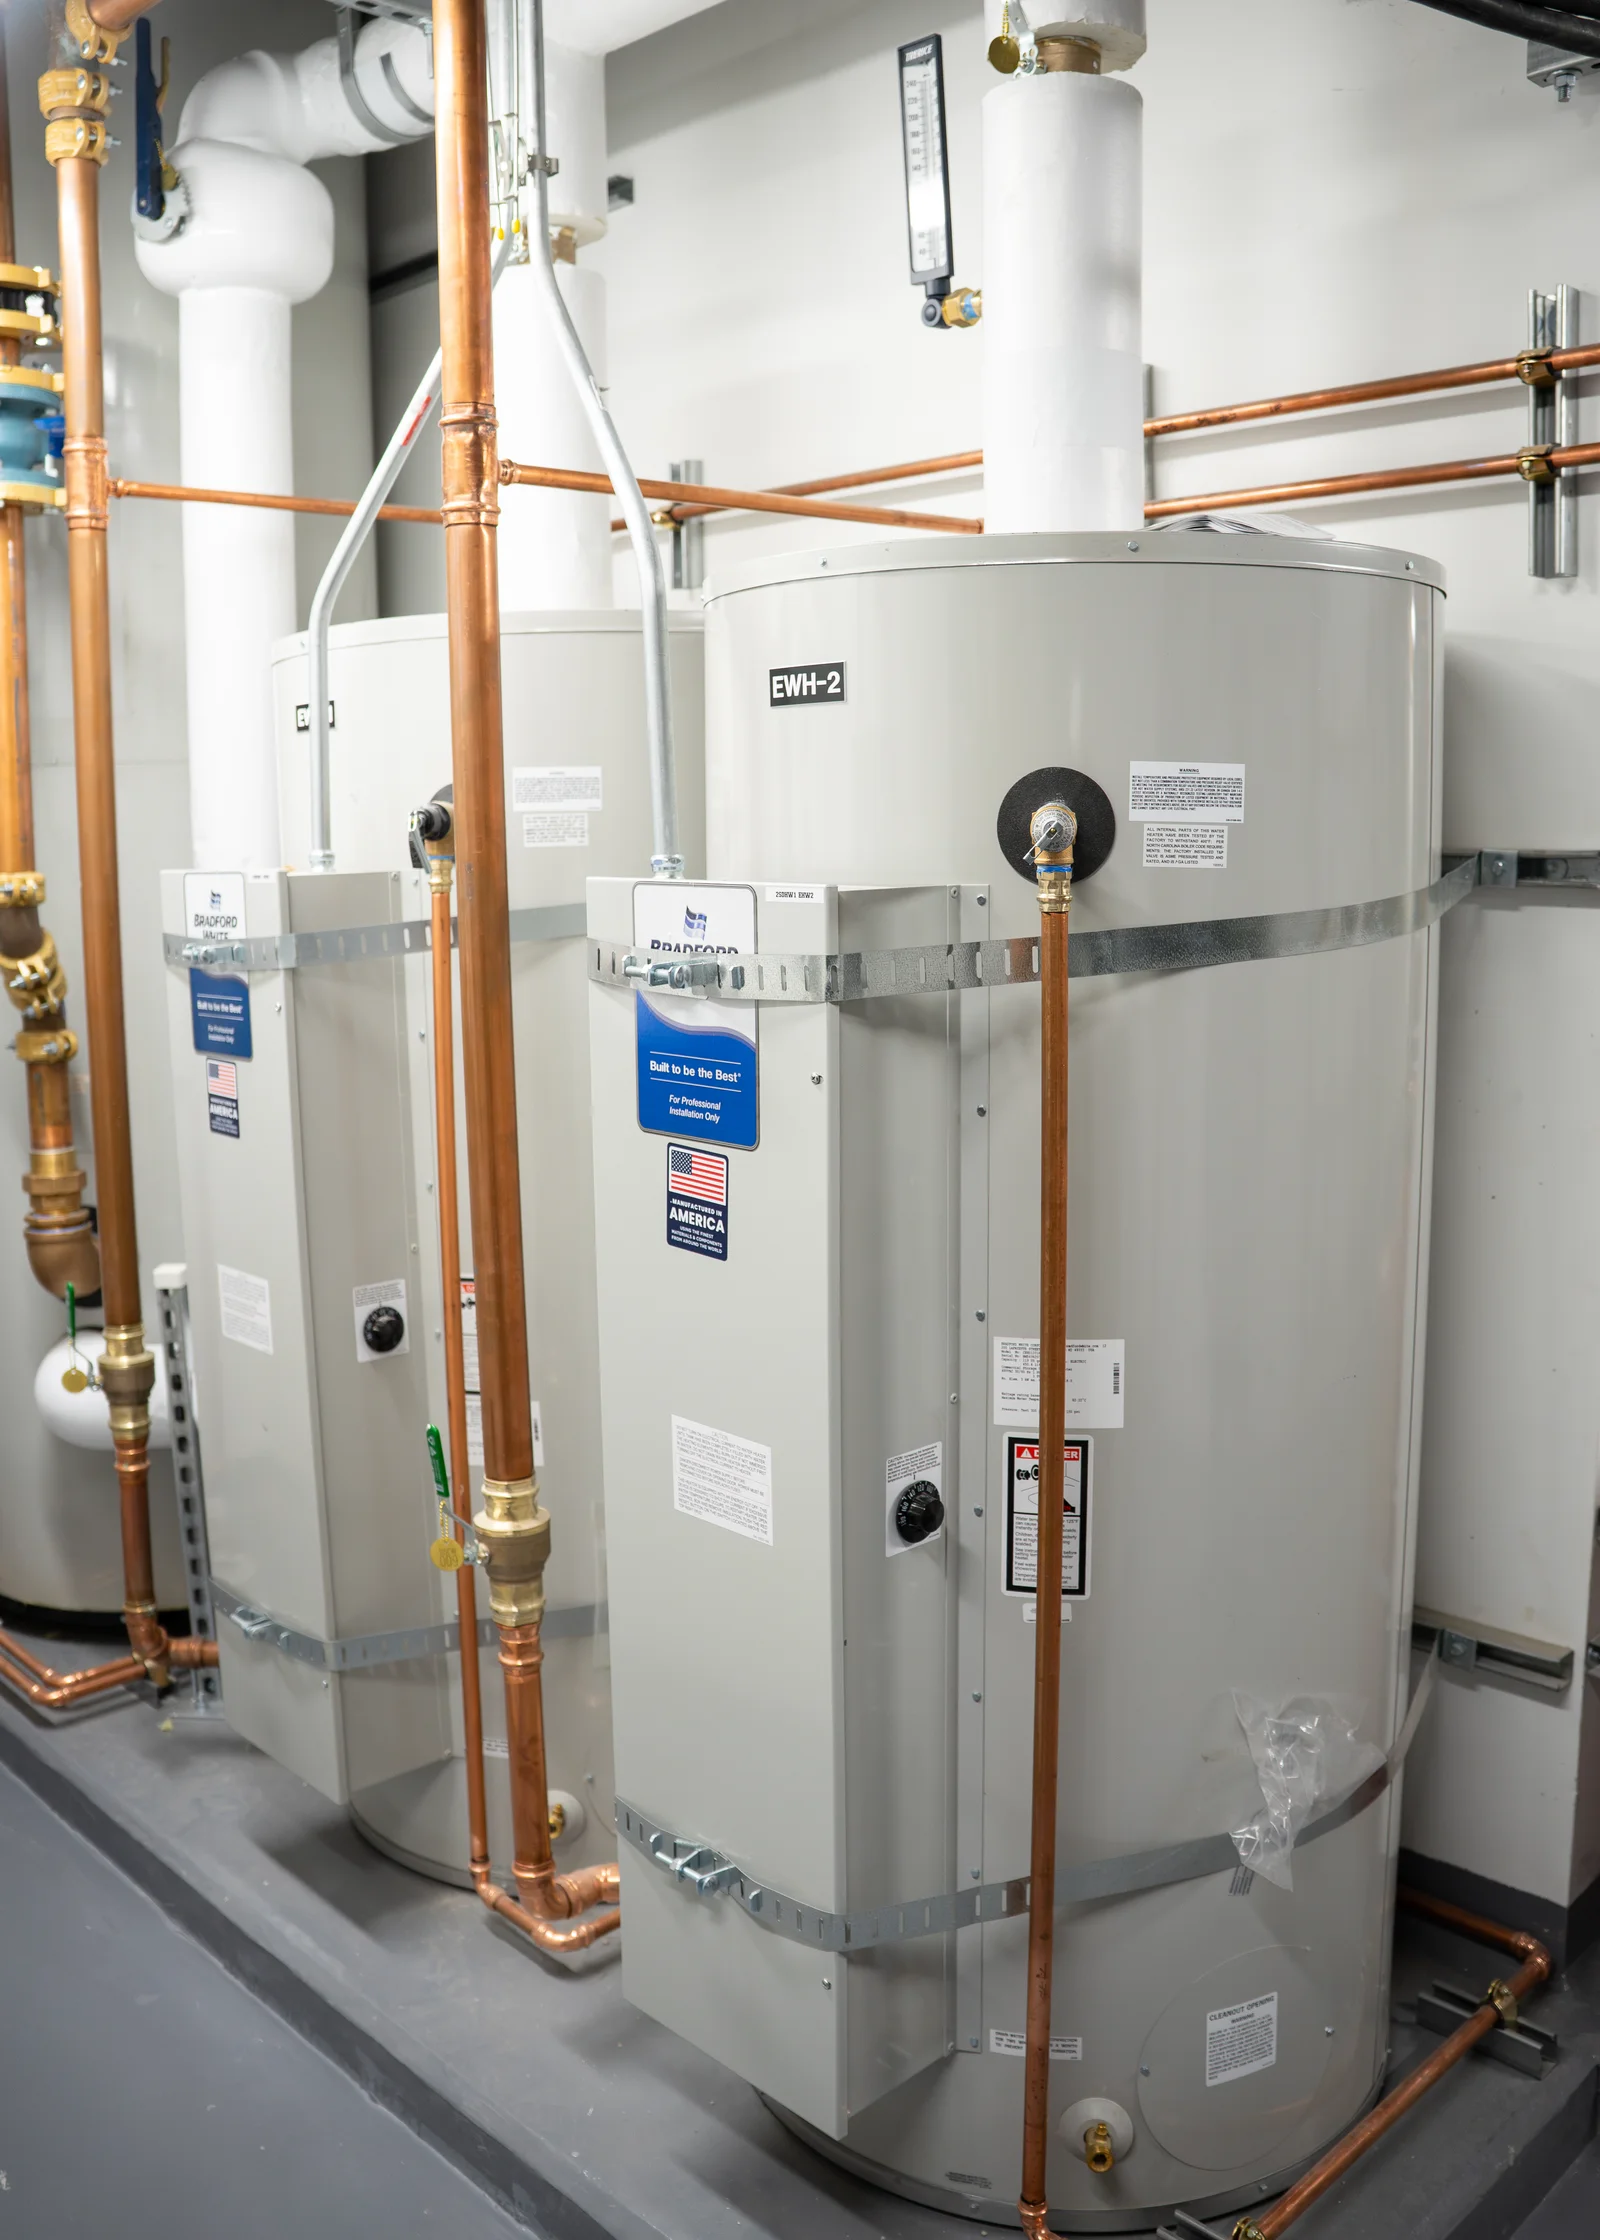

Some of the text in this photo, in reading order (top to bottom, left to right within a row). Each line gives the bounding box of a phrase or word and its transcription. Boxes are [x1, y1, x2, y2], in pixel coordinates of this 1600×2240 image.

[772, 671, 841, 698] EWH-2
[194, 914, 237, 928] BRADFORD
[203, 930, 228, 940] WHITE
[650, 1060, 669, 1073] Built
[671, 1064, 681, 1074] to
[683, 1065, 695, 1076] be
[698, 1067, 713, 1079] the
[669, 1094, 721, 1110] For Professional
[210, 1104, 238, 1120] AMERICA
[669, 1106, 720, 1124] Installation Only
[672, 1198, 715, 1215] MANUFACTURED
[669, 1206, 725, 1234] AMERICA
[696, 1236, 722, 1247] COMPONENTS
[700, 1230, 714, 1239] FINEST
[671, 1235, 683, 1243] FROM
[683, 1238, 699, 1247] AROUND
[708, 1245, 722, 1254] WORLD
[1034, 1449, 1078, 1459] DER
[908, 1489, 916, 1499] 140
[917, 1484, 925, 1492] 120
[1209, 1995, 1274, 2021] CLEANOUT OPENING
